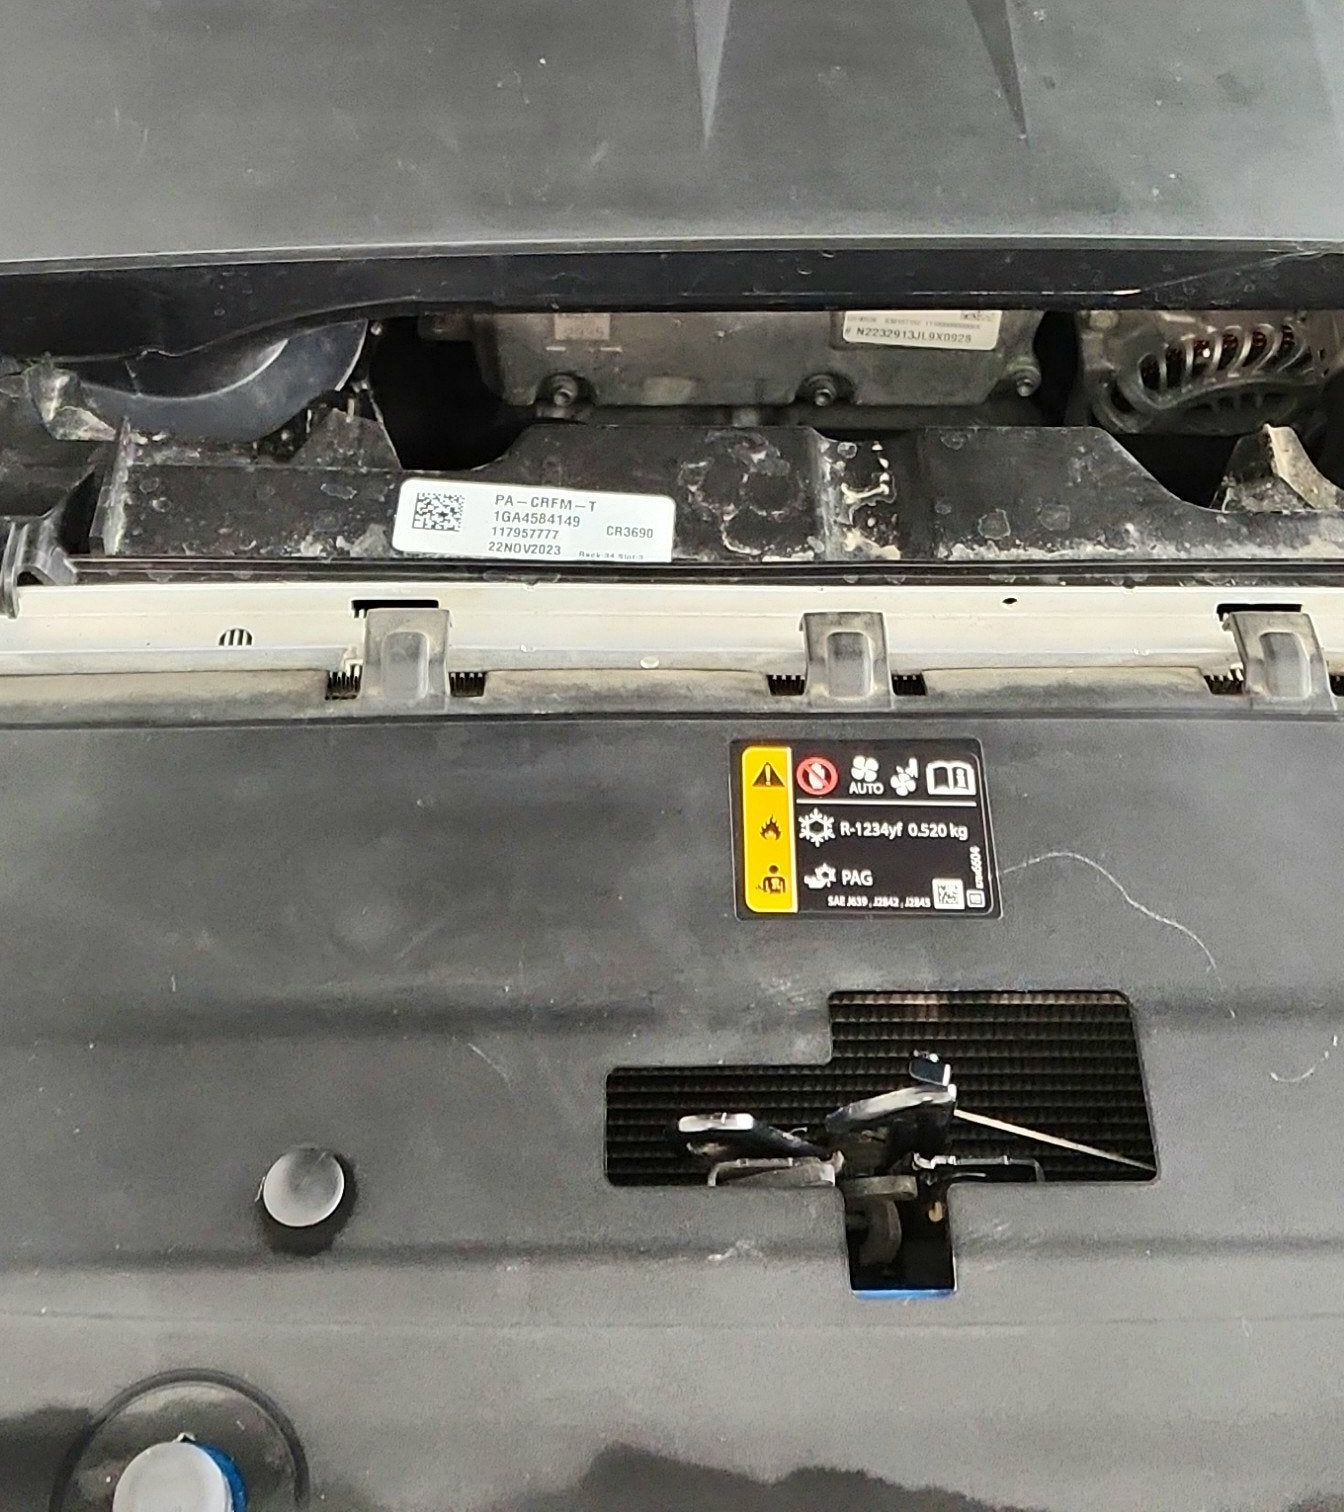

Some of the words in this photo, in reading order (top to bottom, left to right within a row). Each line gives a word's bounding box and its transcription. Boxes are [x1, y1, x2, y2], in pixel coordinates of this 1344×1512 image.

[493, 509, 581, 528] 1GA4584149
[490, 526, 560, 541] 117957777
[605, 524, 655, 540] CR3690
[487, 540, 562, 557] 22NOV2023
[849, 782, 884, 795] AUTO
[840, 821, 903, 840] R-1234yf
[907, 823, 948, 838] 0.520
[949, 824, 969, 841] kg
[841, 869, 874, 887] PAG
[827, 895, 846, 907] SAE
